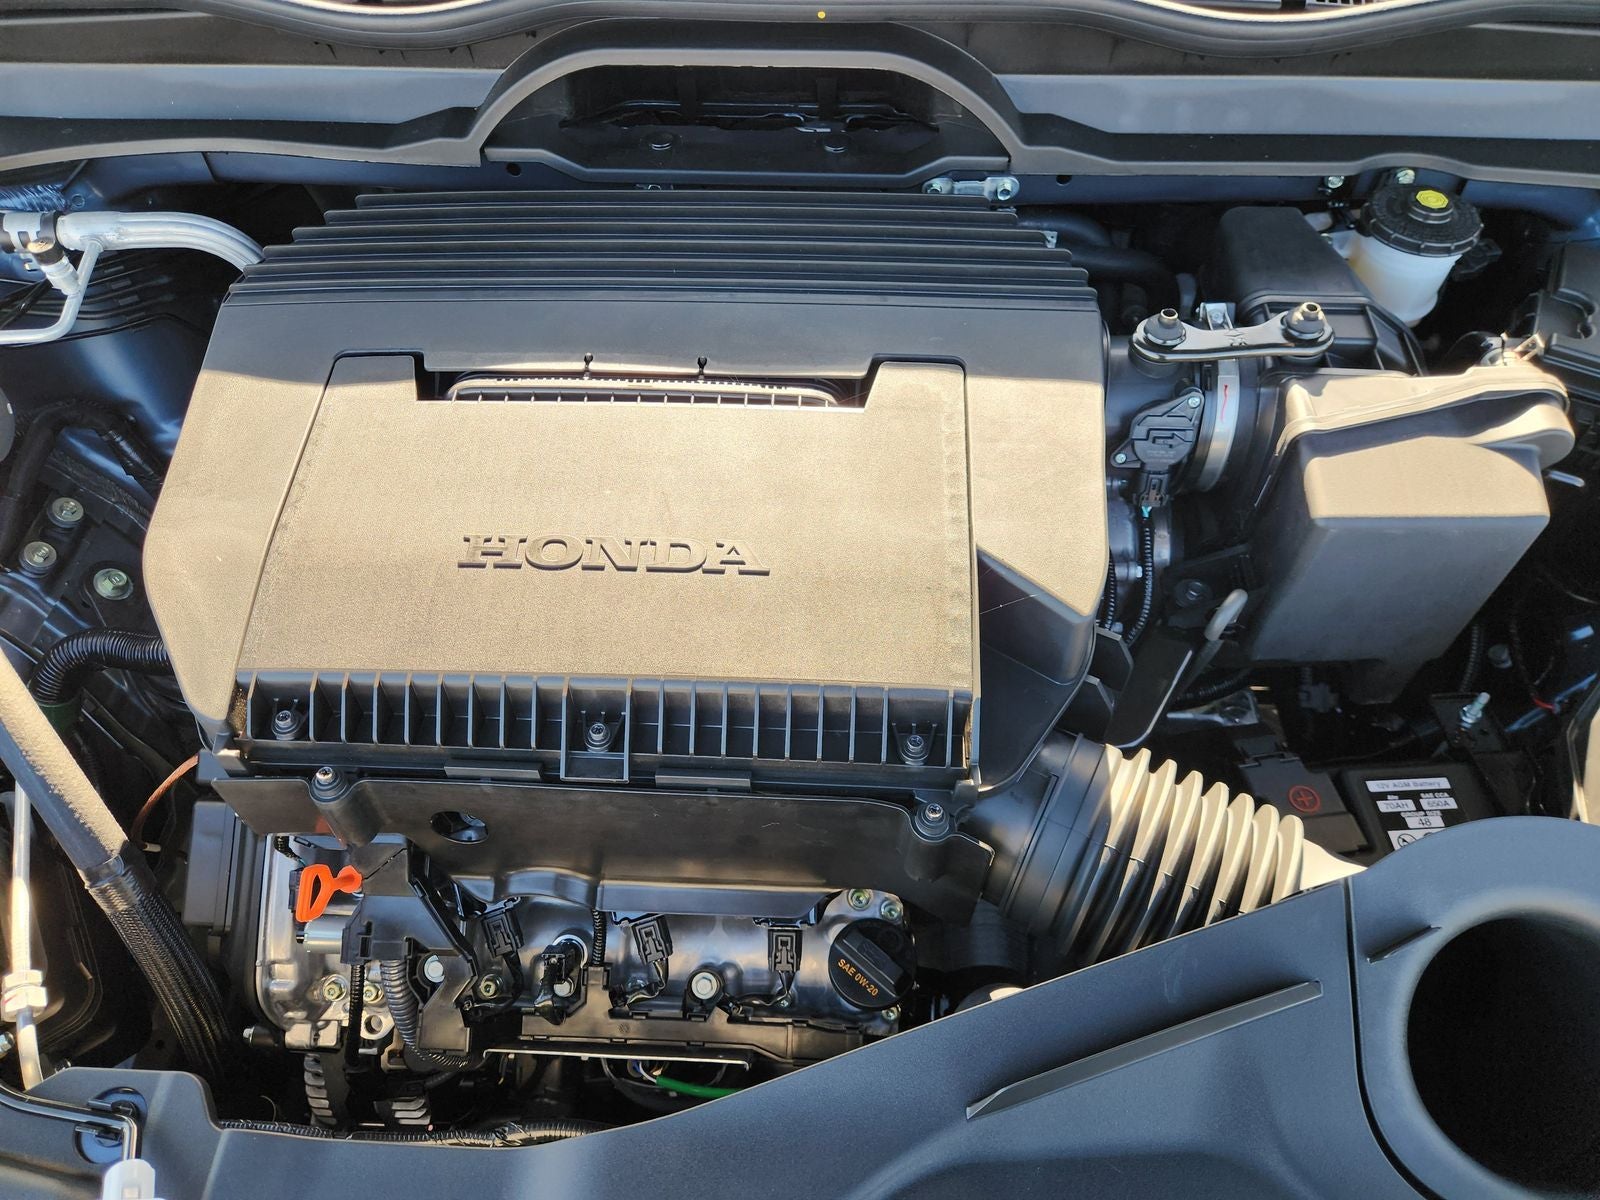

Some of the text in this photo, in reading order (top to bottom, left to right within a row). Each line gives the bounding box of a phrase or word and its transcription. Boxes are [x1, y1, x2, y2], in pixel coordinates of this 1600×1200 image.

[457, 534, 770, 576] HONDA
[1418, 818, 1432, 826] 48
[838, 958, 879, 996] SAE 0W-20
